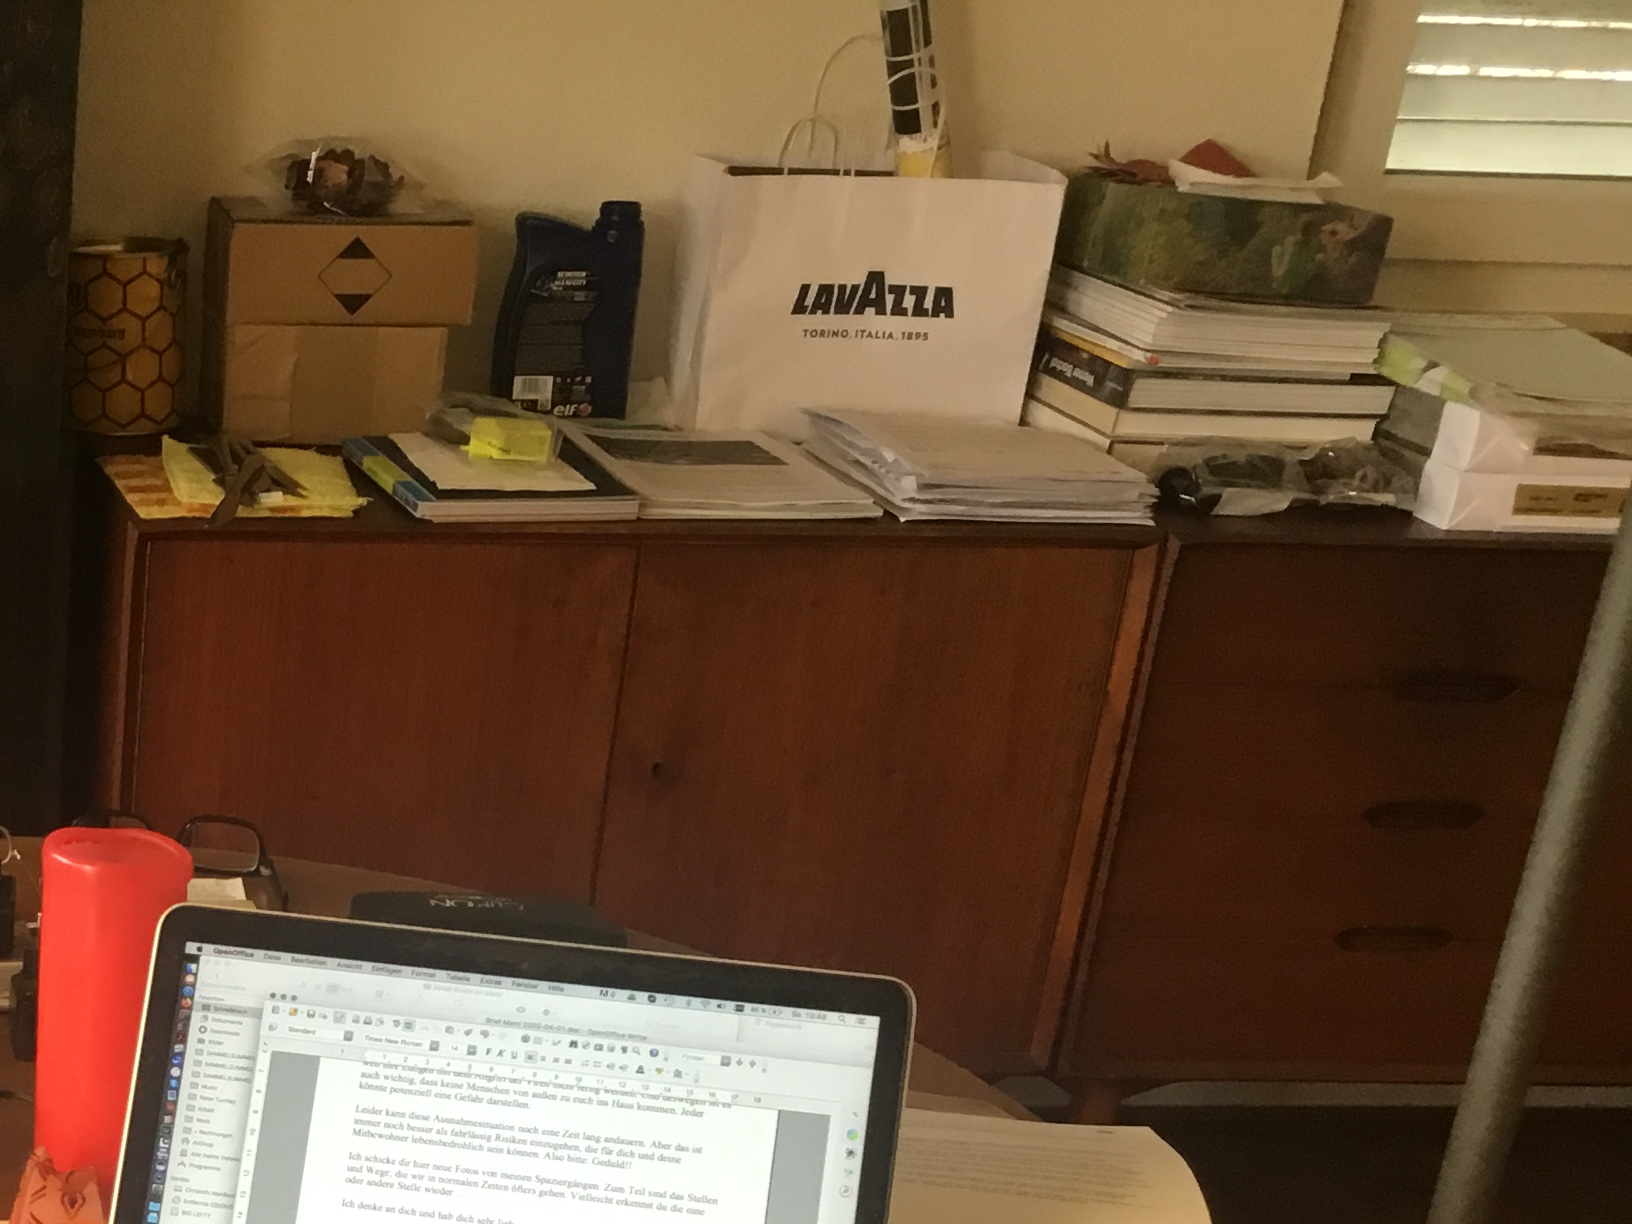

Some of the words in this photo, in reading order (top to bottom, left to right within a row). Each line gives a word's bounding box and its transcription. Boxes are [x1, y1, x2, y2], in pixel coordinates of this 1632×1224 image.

[791, 271, 954, 318] LAVAZZA
[901, 332, 929, 342] 1895
[553, 403, 578, 416] elf
[359, 1081, 388, 1092] könnte
[389, 1085, 432, 1097] potenziell
[434, 1091, 452, 1099] eine
[454, 1093, 484, 1103] Gefahr
[360, 1071, 380, 1080] auch
[419, 1074, 438, 1086] dass
[440, 1079, 464, 1089] keine
[467, 1082, 510, 1095] Menschen
[572, 1096, 593, 1105] euch
[596, 1098, 609, 1106] ins
[612, 1099, 634, 1109] Haus
[352, 1128, 409, 1142] Mitbewohner
[411, 1135, 484, 1151] lebensbedrohlich
[544, 1152, 564, 1161] Also
[354, 1118, 382, 1127] immer
[384, 1122, 404, 1130] noch
[407, 1123, 433, 1133] besser
[435, 1127, 448, 1135] als
[450, 1128, 492, 1143] fahrlässig
[494, 1134, 527, 1145] Risiken
[585, 1145, 598, 1153] die
[601, 1146, 614, 1155] für
[616, 1149, 635, 1158] dich
[638, 1152, 655, 1161] und
[657, 1154, 682, 1164] deine
[355, 1105, 383, 1115] Leider
[385, 1108, 406, 1118] kann
[408, 1111, 430, 1121] diese
[433, 1115, 515, 1131] Ausnahmesituation
[518, 1126, 539, 1134] noch
[562, 1130, 580, 1139] Zeit
[583, 1132, 601, 1144] lang
[650, 1141, 673, 1150] Aber
[674, 1143, 689, 1152] das
[692, 1146, 702, 1154] ist
[345, 1176, 364, 1185] oder
[366, 1177, 394, 1188] andere
[398, 1182, 421, 1192] Stelle
[347, 1165, 363, 1173] und
[395, 1170, 408, 1179] die
[438, 1177, 479, 1187] normalen
[481, 1180, 509, 1191] Zeiten
[571, 1191, 614, 1204] Vielleicht
[616, 1198, 653, 1209] erkennst
[656, 1202, 667, 1211] du
[670, 1204, 684, 1213] die
[686, 1208, 705, 1216] eine
[349, 1152, 362, 1161] Ich
[364, 1155, 396, 1165] schicke
[398, 1158, 411, 1167] dir
[413, 1160, 430, 1169] hier
[432, 1164, 453, 1172] neue
[455, 1165, 479, 1175] Fotos
[482, 1170, 497, 1178] von
[500, 1173, 532, 1182] meinen
[604, 1183, 625, 1193] Zum
[629, 1186, 645, 1196] Teil
[669, 1192, 684, 1200] das
[687, 1193, 718, 1205] Stellen
[342, 1199, 355, 1208] Ich
[358, 1201, 383, 1211] denke
[398, 1206, 416, 1216] dich
[438, 1211, 453, 1220] hab
[456, 1214, 474, 1223] dich
[477, 1217, 495, 1224] sehr
